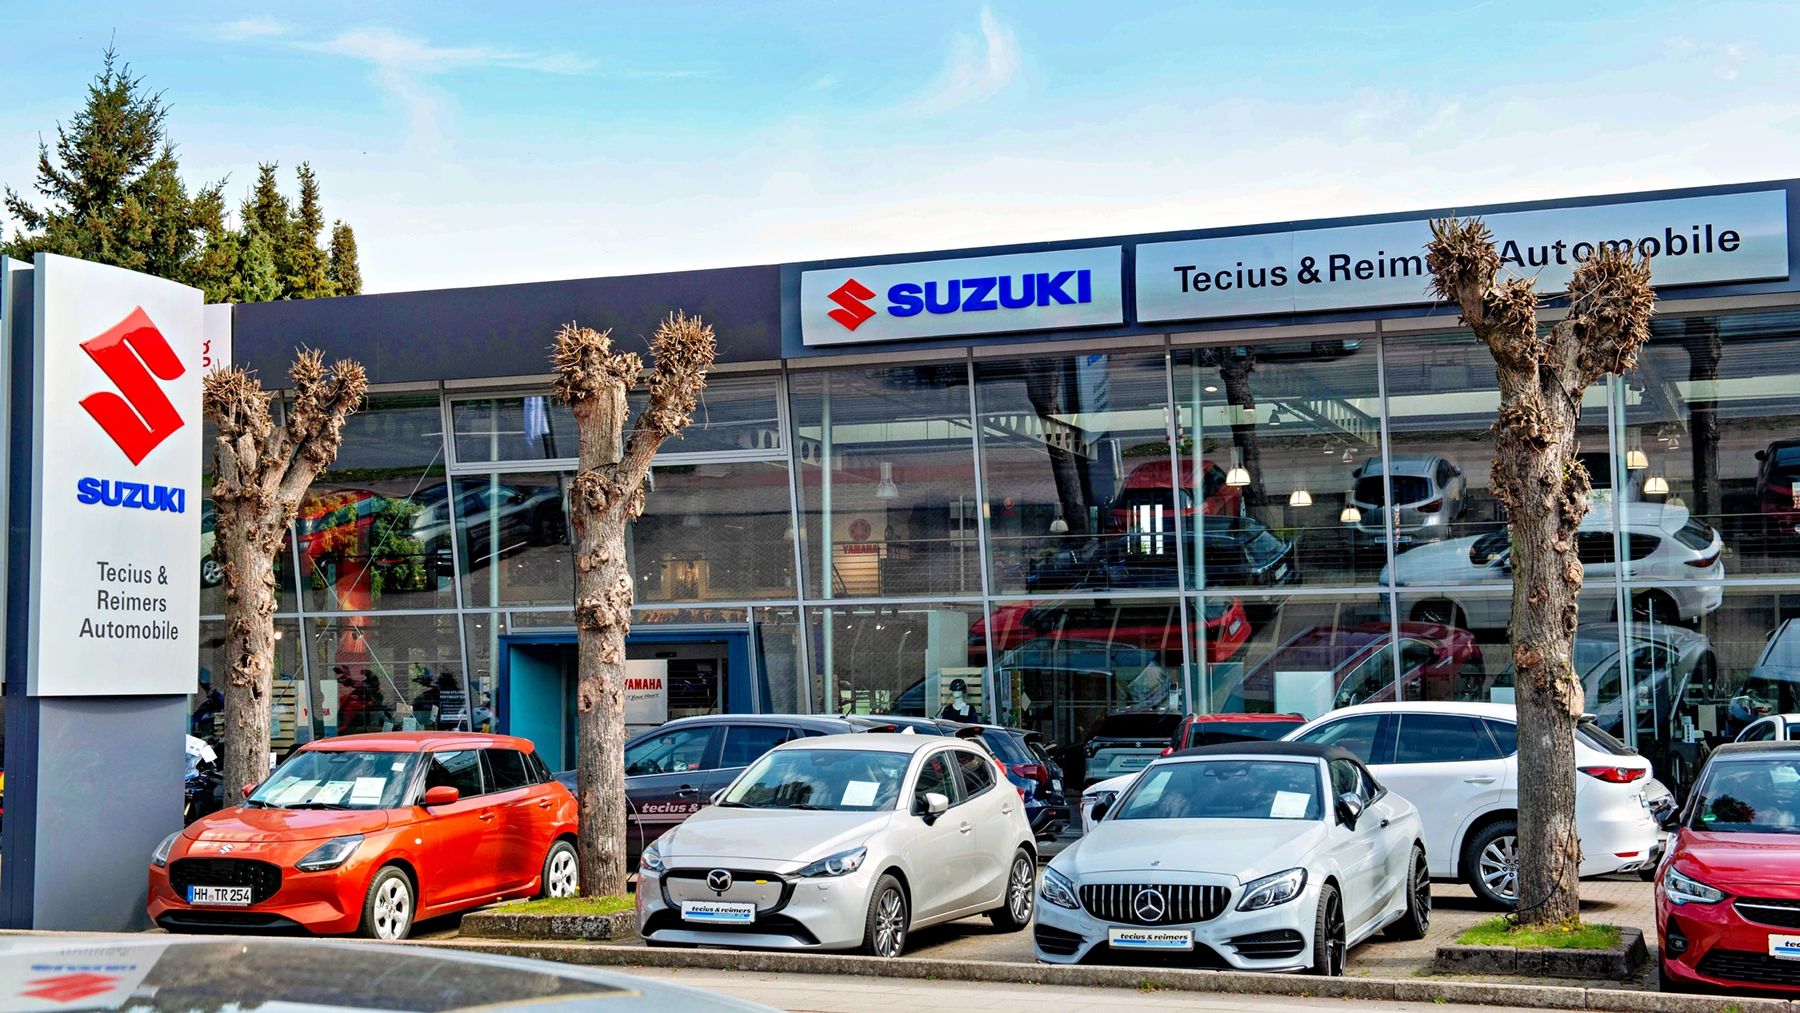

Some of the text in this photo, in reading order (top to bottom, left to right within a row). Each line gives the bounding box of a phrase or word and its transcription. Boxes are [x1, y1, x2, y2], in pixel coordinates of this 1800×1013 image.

[1173, 261, 1288, 293] Tecius
[1296, 256, 1322, 285] &
[1328, 250, 1436, 283] Reim
[887, 269, 1092, 318] SUZUKI
[77, 477, 186, 514] SUZUKI
[843, 544, 878, 554] YAMAHA
[97, 561, 168, 585] Tecius &
[97, 589, 167, 612] Reimers
[79, 617, 179, 641] Automobile
[642, 802, 687, 813] tecius
[688, 803, 699, 812] &
[194, 888, 249, 901] HH TR 254
[721, 906, 751, 914] reimers
[1120, 932, 1146, 940] tecius
